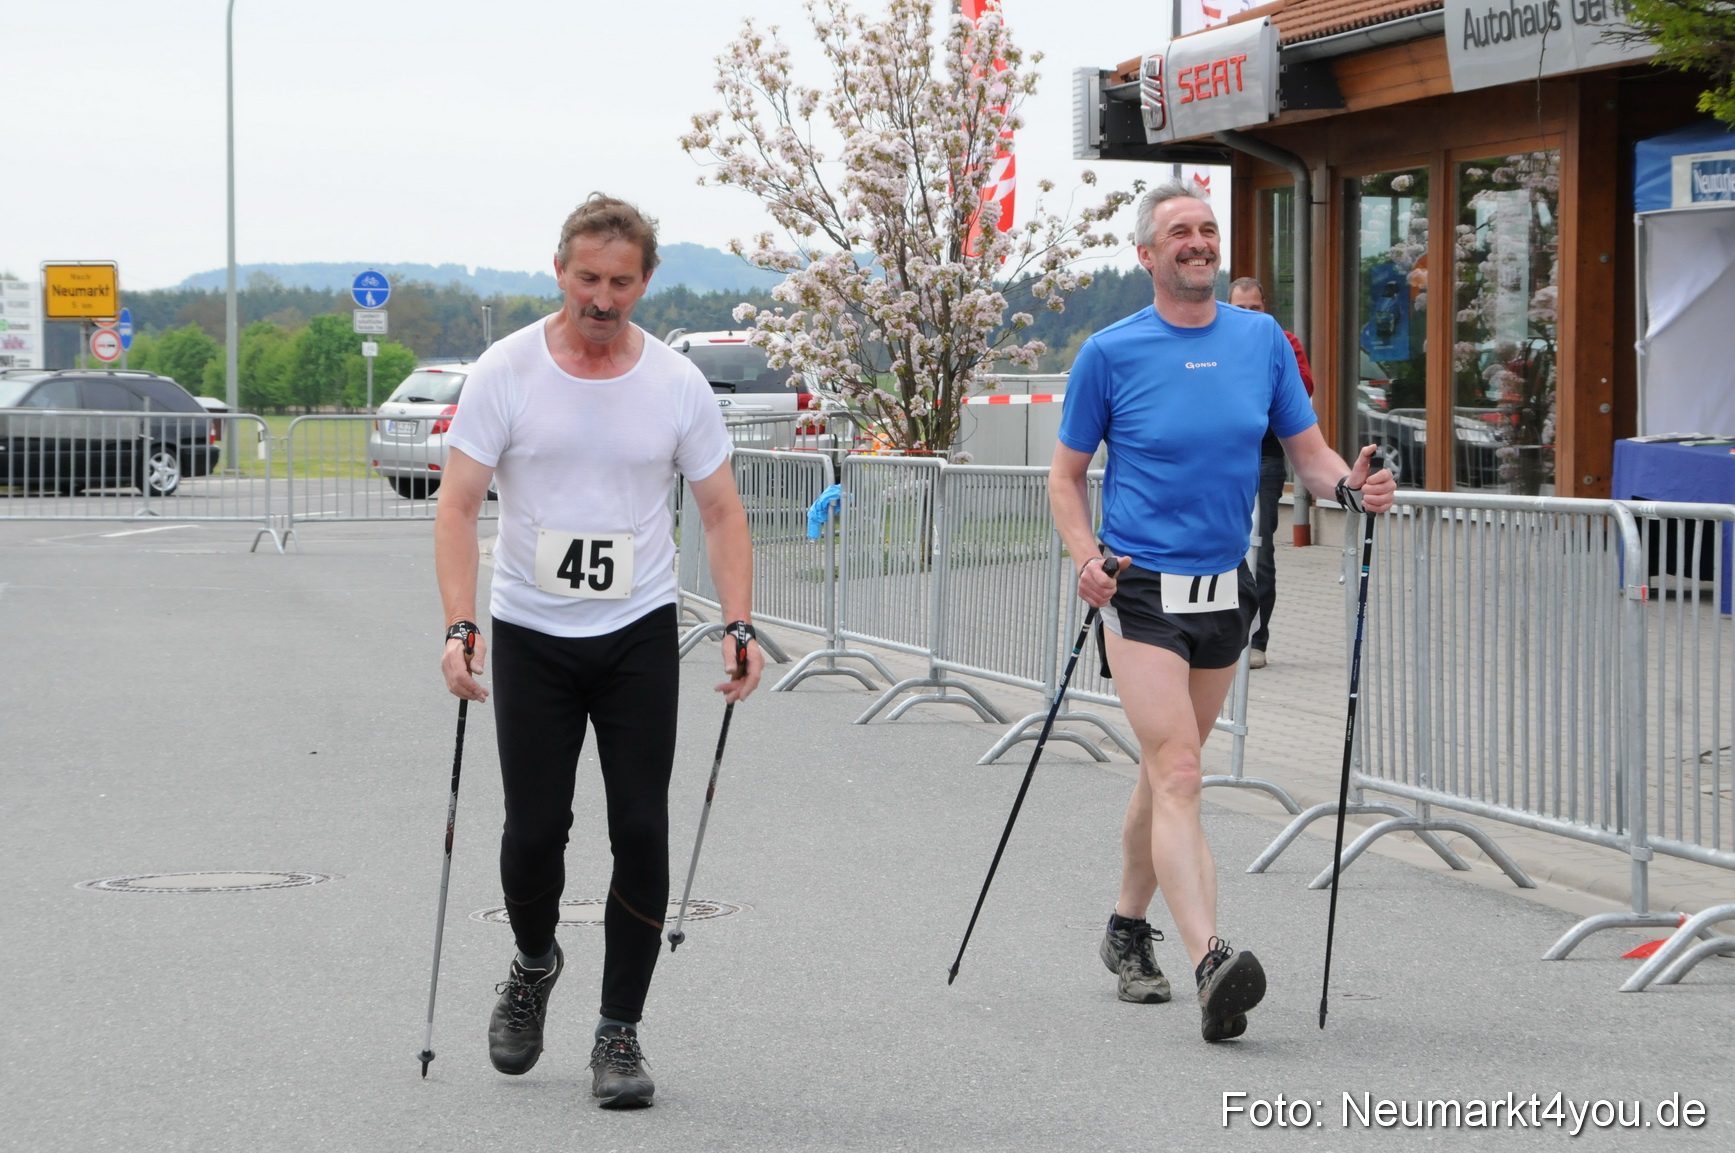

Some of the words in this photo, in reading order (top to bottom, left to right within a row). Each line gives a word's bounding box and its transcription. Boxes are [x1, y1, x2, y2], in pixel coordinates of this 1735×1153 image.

[1463, 0, 1562, 50] Autohaus
[1178, 53, 1248, 105] SEAT
[52, 285, 109, 297] Neumarkt
[70, 273, 91, 281] Nach
[556, 538, 614, 592] 45
